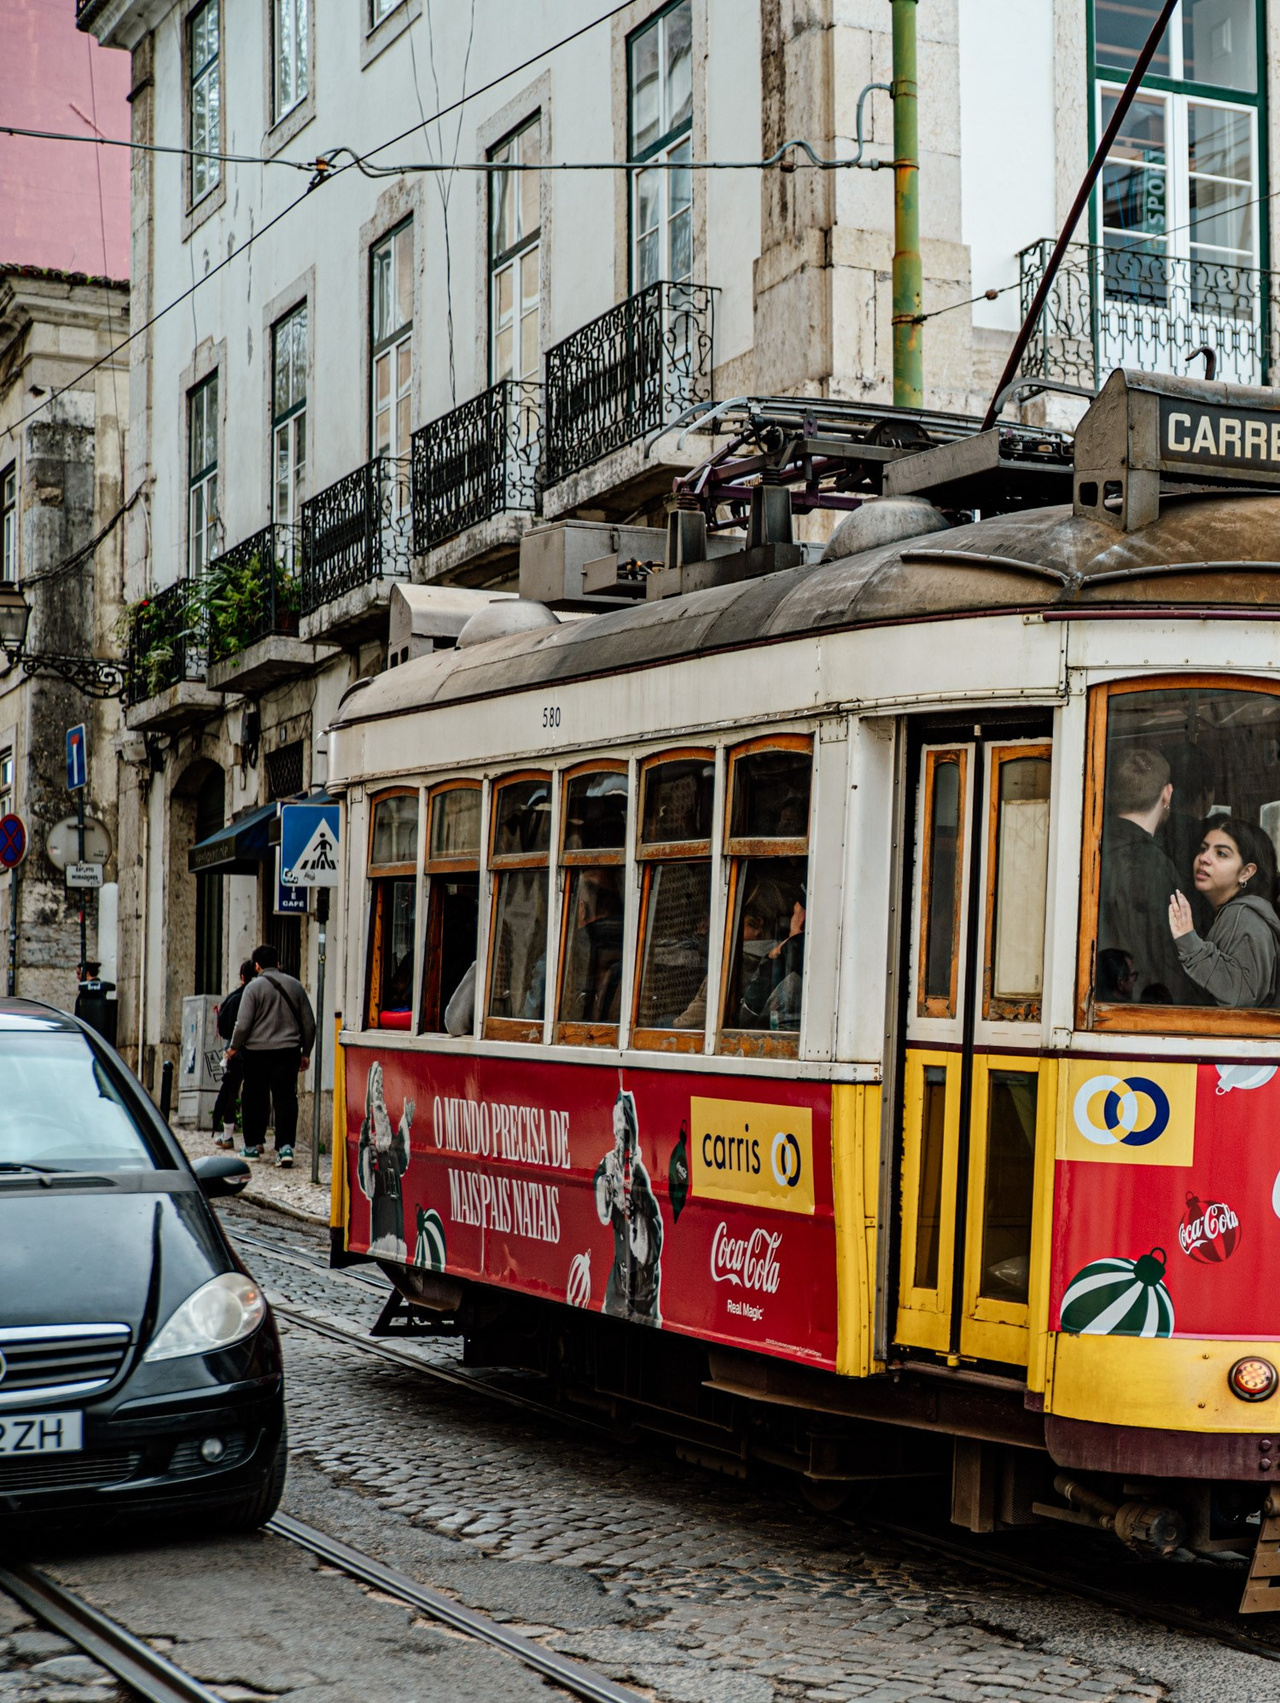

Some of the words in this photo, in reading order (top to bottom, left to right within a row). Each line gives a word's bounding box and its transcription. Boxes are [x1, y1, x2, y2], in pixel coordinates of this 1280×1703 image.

[542, 706, 561, 728] 580
[433, 1095, 443, 1150] O
[443, 1097, 490, 1157] MUNDO
[491, 1102, 550, 1166] PRECISA
[550, 1110, 571, 1169] DE
[702, 1123, 761, 1175] carris
[448, 1168, 481, 1227] MAIS
[480, 1174, 512, 1233] PAIS
[512, 1179, 561, 1244] NATAIS
[710, 1221, 783, 1294] Coca-Cola
[727, 1299, 742, 1316] Real
